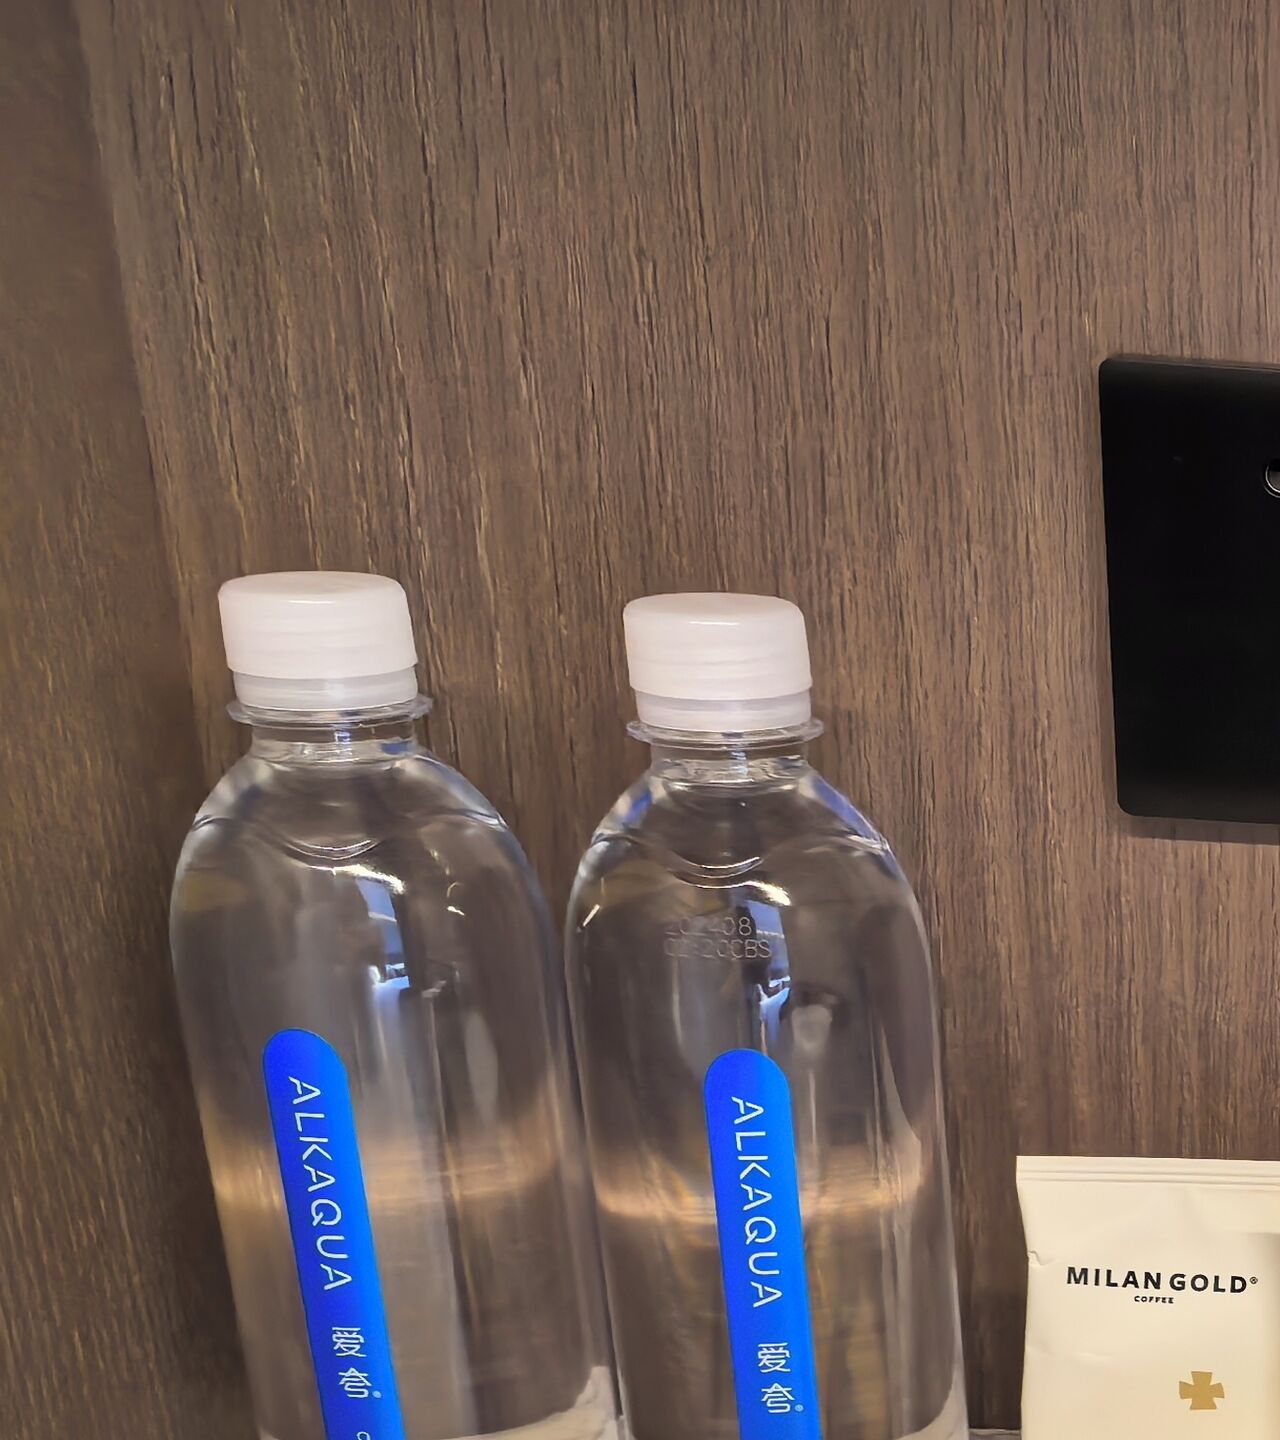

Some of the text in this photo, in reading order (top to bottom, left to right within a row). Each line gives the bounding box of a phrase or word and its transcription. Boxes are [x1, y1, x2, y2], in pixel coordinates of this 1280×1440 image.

[288, 1076, 353, 1291] ALKAQUA
[731, 1096, 783, 1308] ALKAQUA
[1066, 1266, 1162, 1291] MILAN
[1133, 1295, 1175, 1305] COFFEE
[331, 1326, 372, 1399] 爱夸
[757, 1342, 796, 1414] 爱夸
